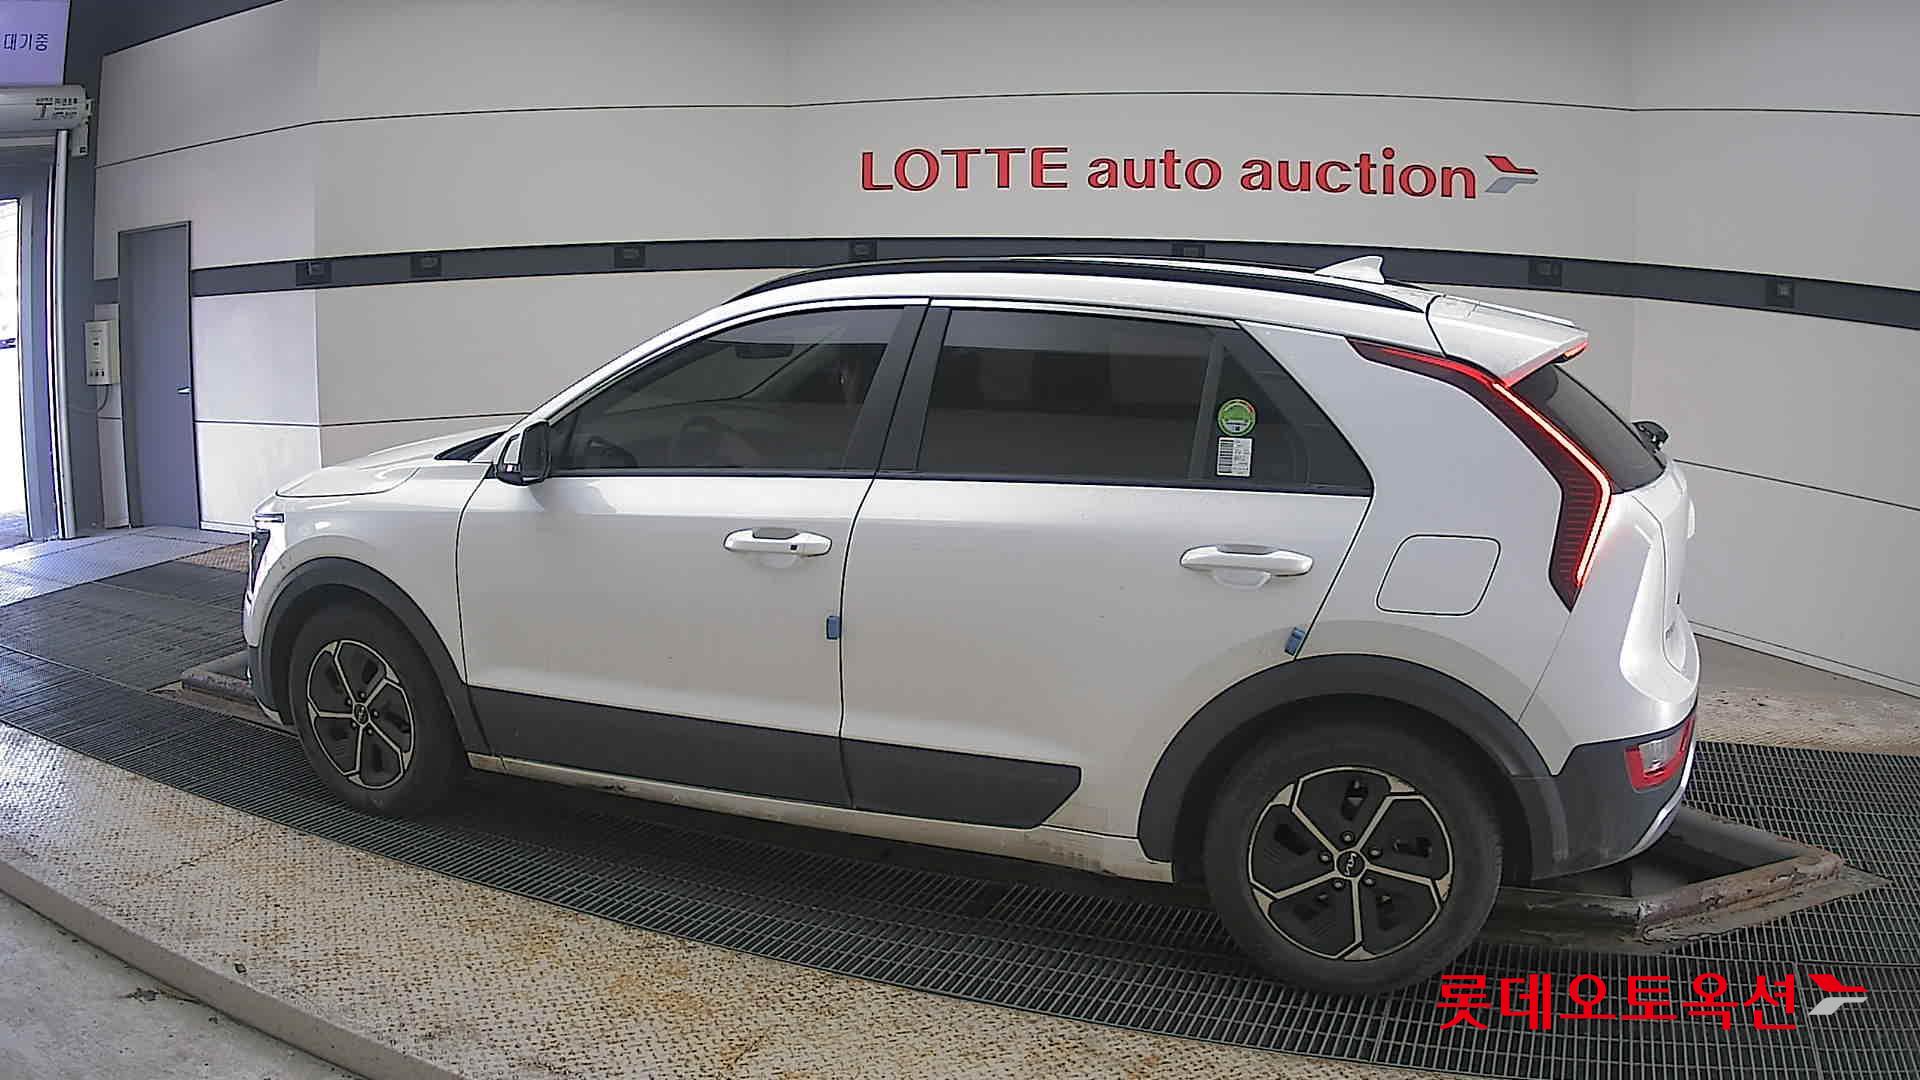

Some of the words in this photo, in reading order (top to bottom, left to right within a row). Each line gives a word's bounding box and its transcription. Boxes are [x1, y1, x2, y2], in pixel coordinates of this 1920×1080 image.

[3, 33, 49, 52] 대기중
[862, 147, 1069, 191] LOTTE
[1088, 150, 1222, 189] auto
[1241, 148, 1477, 199] auction
